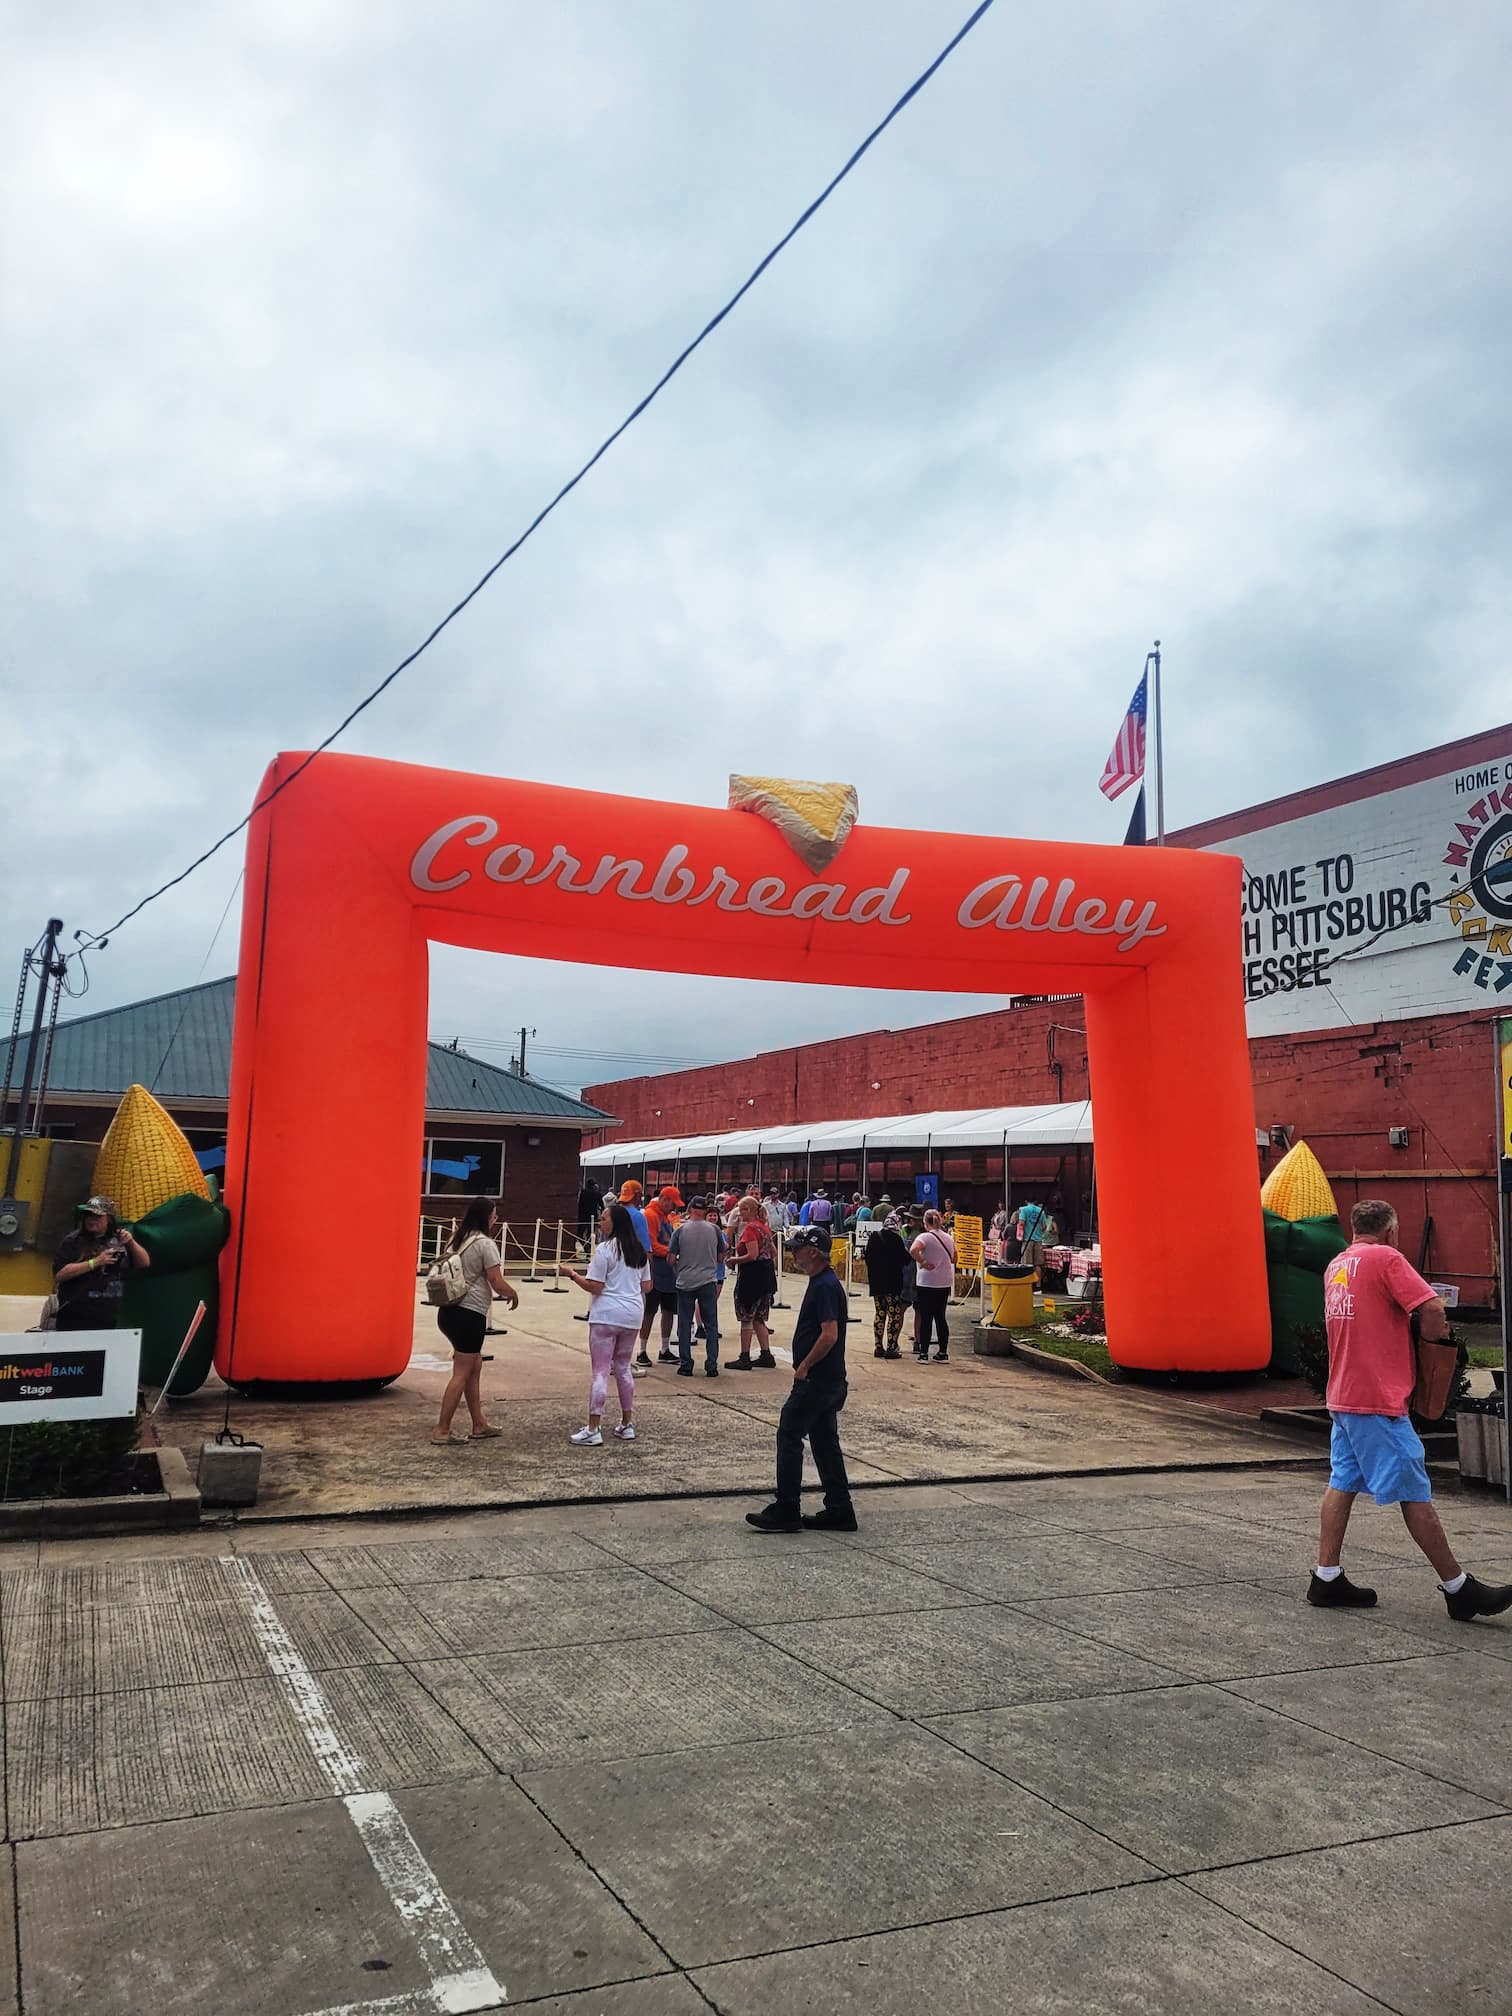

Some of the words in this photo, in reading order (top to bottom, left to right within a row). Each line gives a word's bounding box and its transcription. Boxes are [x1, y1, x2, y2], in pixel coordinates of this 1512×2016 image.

[1455, 767, 1499, 794] HOME
[410, 814, 913, 925] Cornbread
[956, 874, 1168, 952] Alley
[1316, 854, 1354, 897] TO
[1272, 881, 1431, 951] PITTSBURG
[1243, 948, 1332, 999] ESSEE
[20, 1385, 53, 1396] Stage
